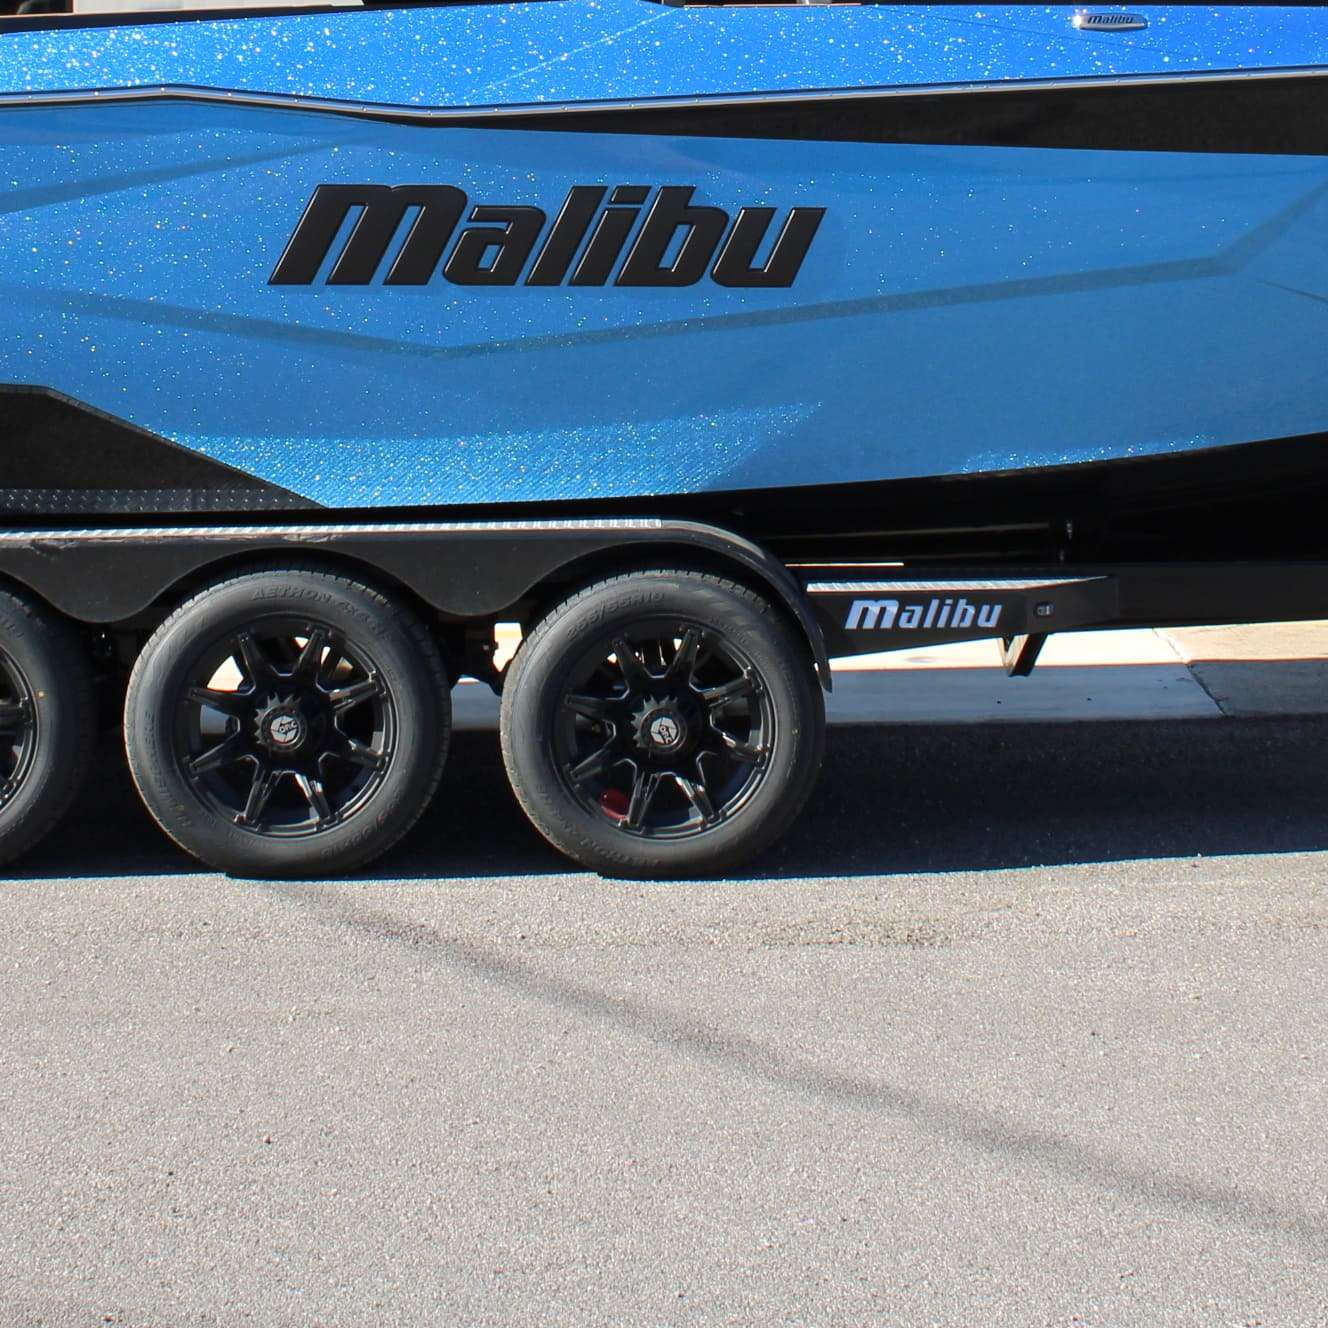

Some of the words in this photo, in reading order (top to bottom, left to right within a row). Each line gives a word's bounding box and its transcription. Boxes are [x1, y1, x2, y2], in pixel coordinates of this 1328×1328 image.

[1087, 15, 1134, 24] Malibu
[268, 183, 827, 288] Malibu
[845, 598, 1003, 630] Malibu
